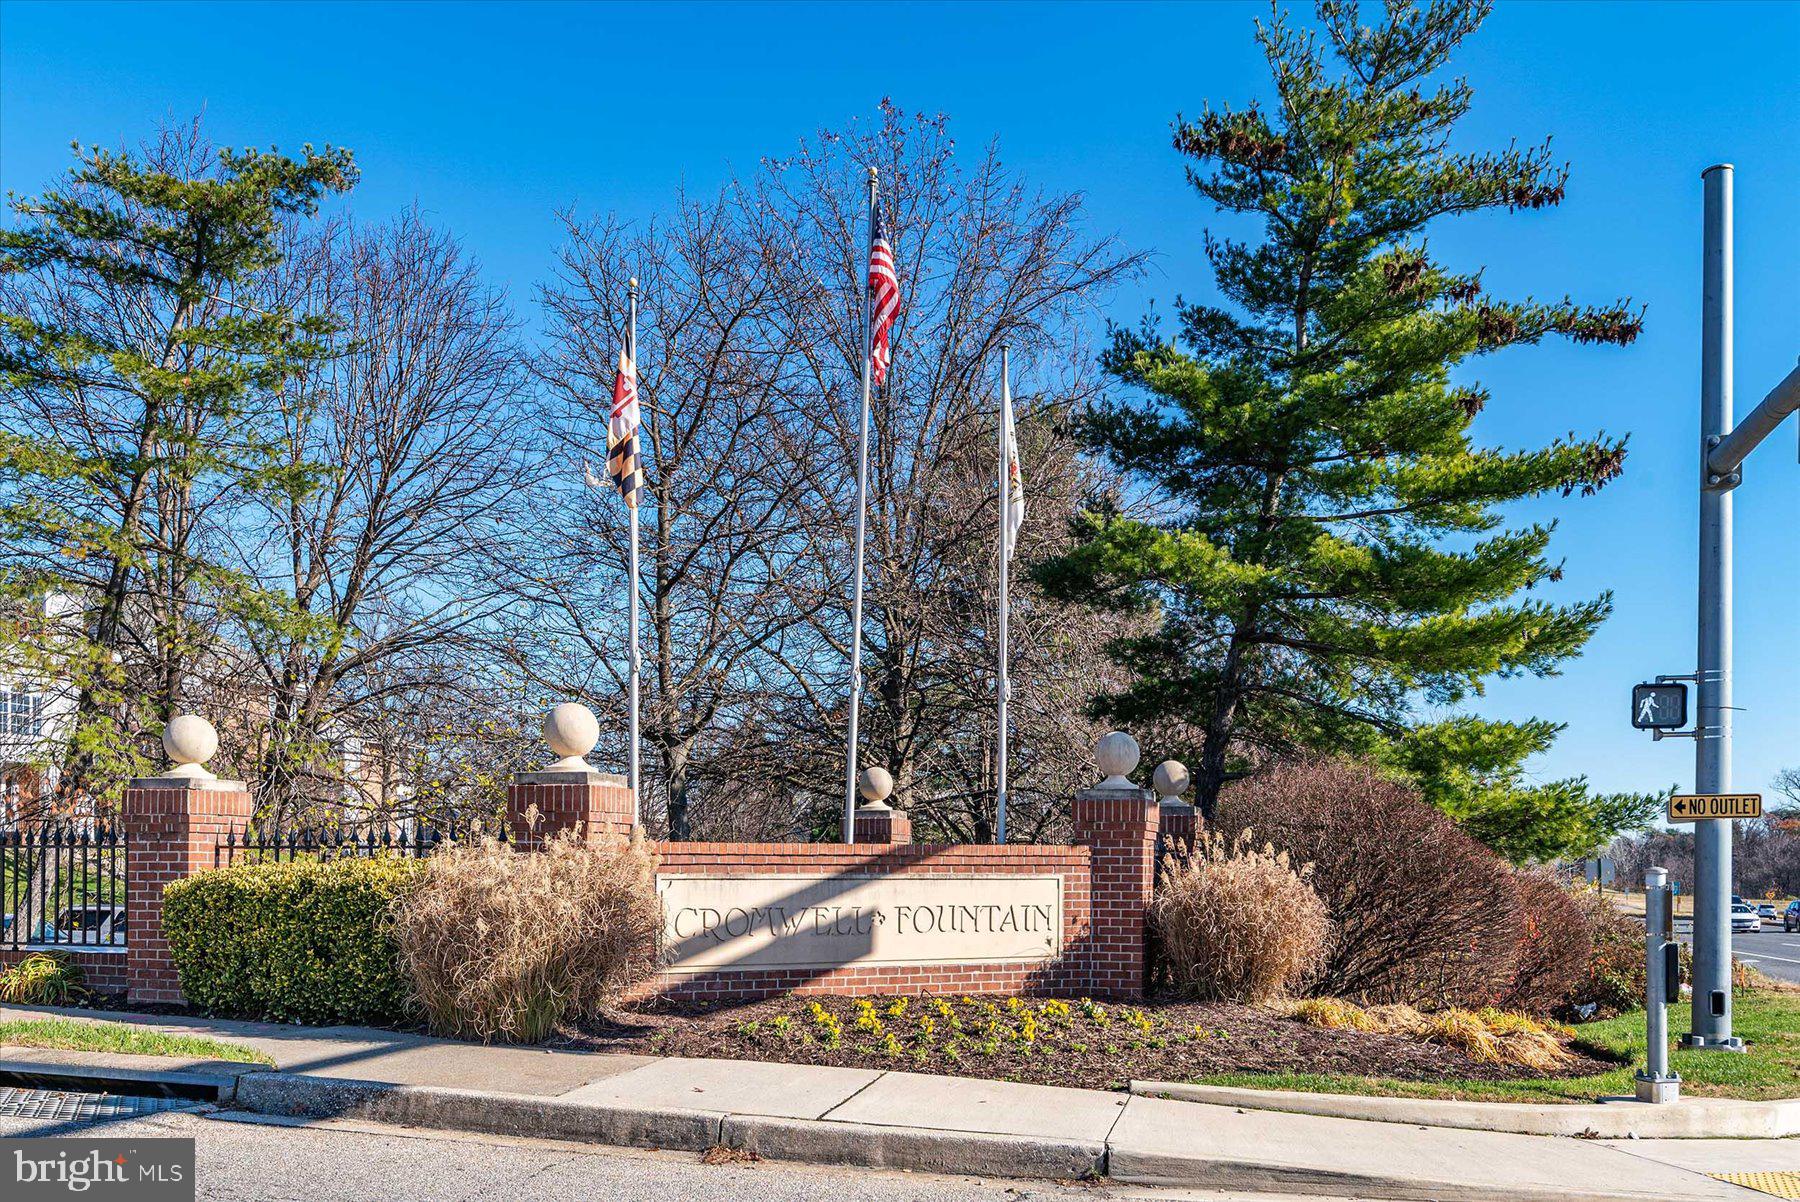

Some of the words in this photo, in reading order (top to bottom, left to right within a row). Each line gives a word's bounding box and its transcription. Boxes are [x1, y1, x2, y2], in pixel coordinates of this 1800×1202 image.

[1689, 798, 1706, 815] NO
[1710, 798, 1758, 815] OUTLET
[674, 906, 873, 941] CROMWELL
[893, 904, 1053, 934] FOUNTAIN
